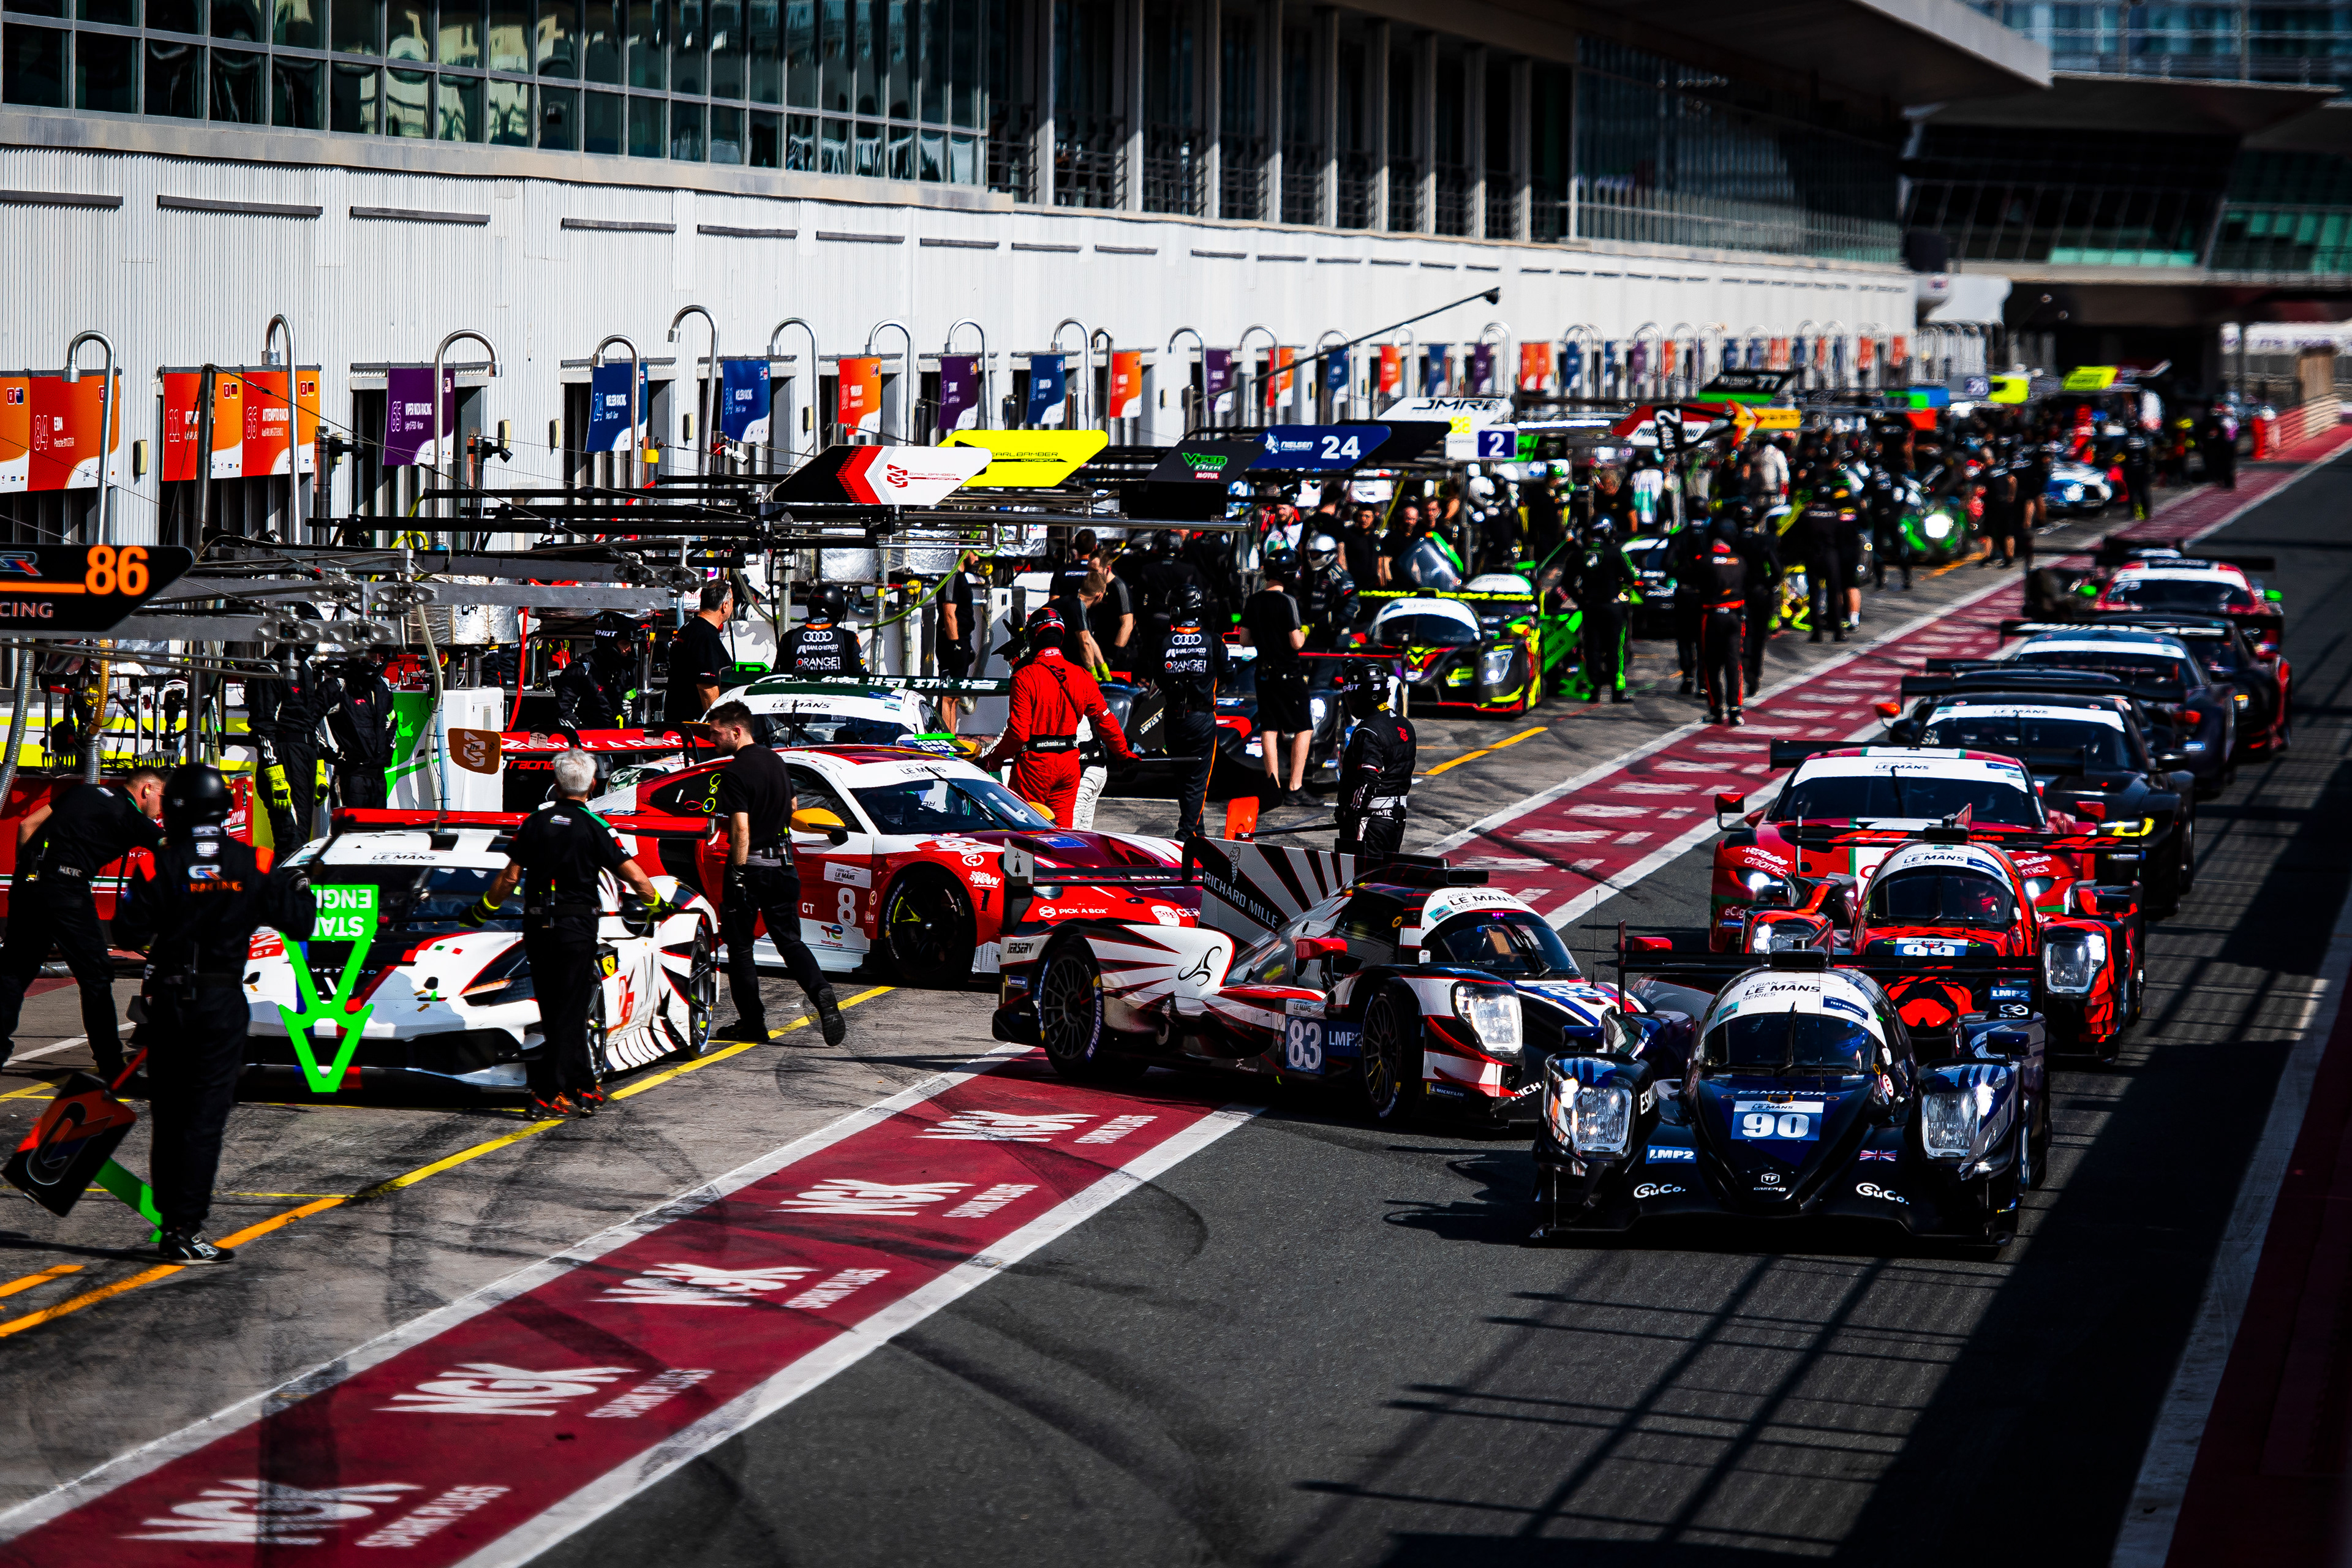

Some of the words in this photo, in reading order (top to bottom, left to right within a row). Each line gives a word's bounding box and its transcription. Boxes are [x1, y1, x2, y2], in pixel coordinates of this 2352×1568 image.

[168, 409, 180, 442] 11
[246, 405, 257, 439] 66
[34, 415, 48, 451] 84
[1321, 435, 1361, 459] 24
[1488, 432, 1506, 456] 2
[85, 545, 149, 596] 86
[0, 601, 54, 618] CING
[796, 656, 841, 667] ORANGE1
[1036, 740, 1066, 748] mechanix.com
[1744, 856, 1789, 876] aviamic
[1903, 856, 1920, 864] LE
[311, 889, 372, 909] ENGI
[837, 888, 856, 927] 8
[1204, 871, 1246, 908] RICHARD
[1248, 900, 1278, 929] MILLE
[1449, 897, 1468, 906] LE
[1472, 894, 1517, 904] MANS
[1454, 902, 1486, 911] SERIES
[802, 902, 815, 914] GT
[1177, 908, 1202, 918] CER
[312, 916, 364, 937] STA
[251, 948, 275, 957] GT
[1539, 986, 1606, 998] 83
[1744, 986, 1764, 997] LE
[1770, 984, 1822, 993] MANS
[1749, 981, 1779, 989] ASIAN
[1741, 992, 1776, 1002] SERIES
[1087, 998, 1102, 1058] MICHELIN
[1289, 1019, 1322, 1070] 83
[1436, 1088, 1465, 1097] MICHELIN
[1742, 1113, 1810, 1138] 90
[1649, 1149, 1695, 1159] LMP2
